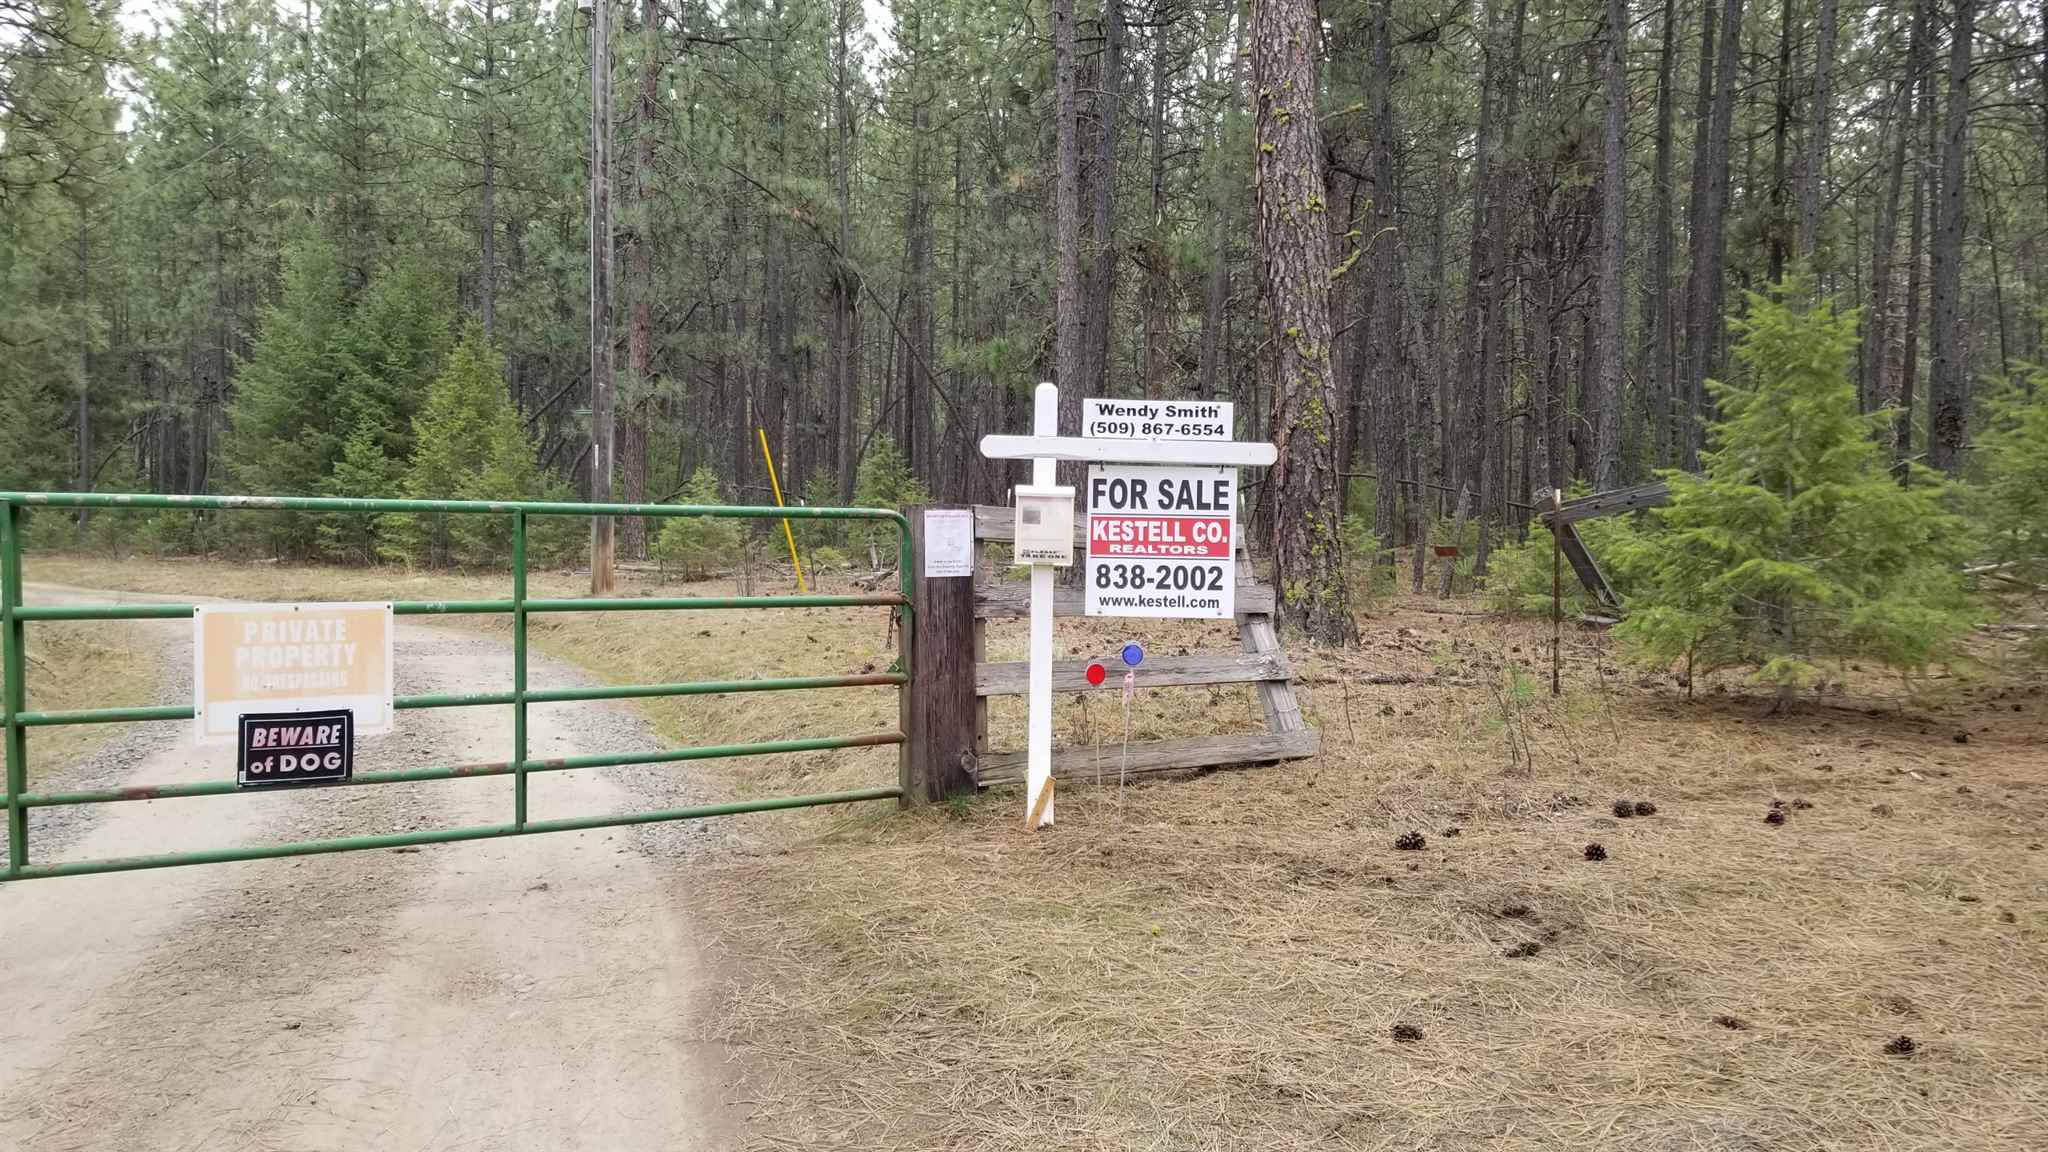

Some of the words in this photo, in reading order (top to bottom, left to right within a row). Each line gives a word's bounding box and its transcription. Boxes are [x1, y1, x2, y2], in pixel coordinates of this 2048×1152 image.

[1098, 403, 1159, 420] Wendy
[1165, 405, 1219, 419] Smith
[1090, 421, 1135, 437] (509)
[1142, 422, 1225, 436] 867-6554
[1092, 478, 1148, 510] FOR
[1157, 479, 1230, 511] SALE
[1093, 519, 1186, 543] KESTELL
[1192, 521, 1228, 544] CO.
[1109, 544, 1209, 556] REALTORS
[1096, 564, 1224, 591] 838-2002
[1099, 595, 1220, 609] www.kestell.com
[243, 618, 347, 643] PRIVATE
[234, 640, 358, 669] PROPERTY
[252, 724, 342, 748] BEWARE
[250, 756, 275, 774] of
[279, 751, 342, 773] DOG
